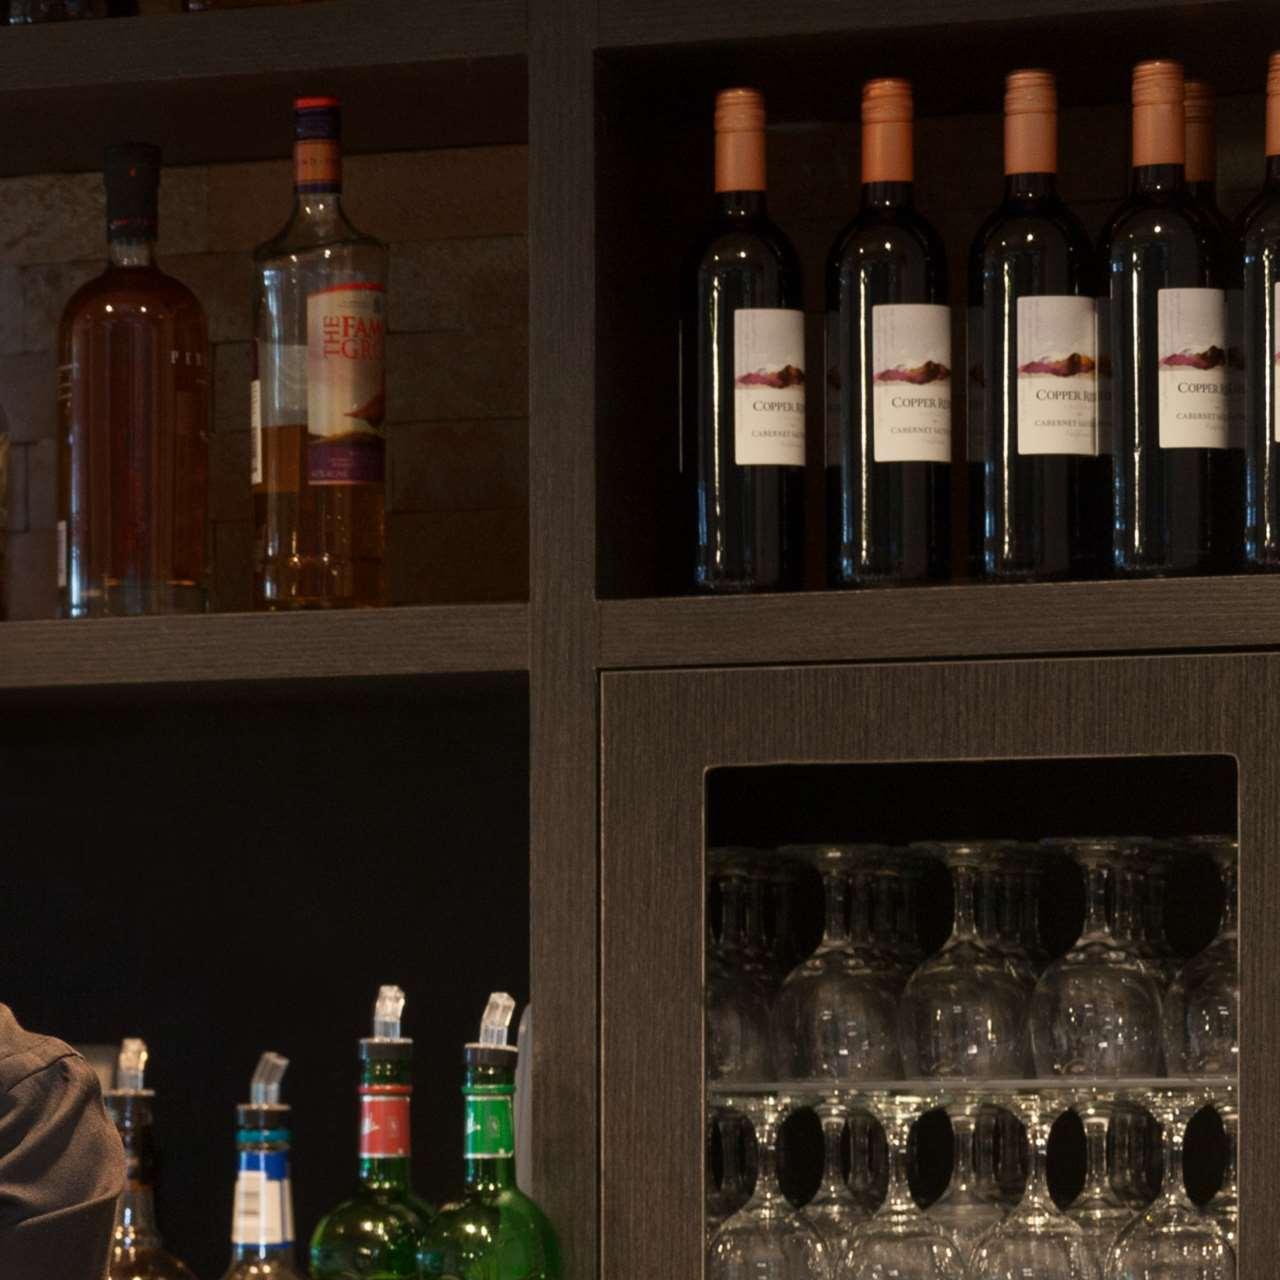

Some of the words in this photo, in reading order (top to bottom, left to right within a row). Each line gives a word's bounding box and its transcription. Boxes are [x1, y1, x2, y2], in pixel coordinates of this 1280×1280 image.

[323, 315, 339, 360] THE
[1178, 381, 1218, 394] COPPER
[1035, 388, 1082, 401] COPPER
[891, 396, 936, 409] COPPER
